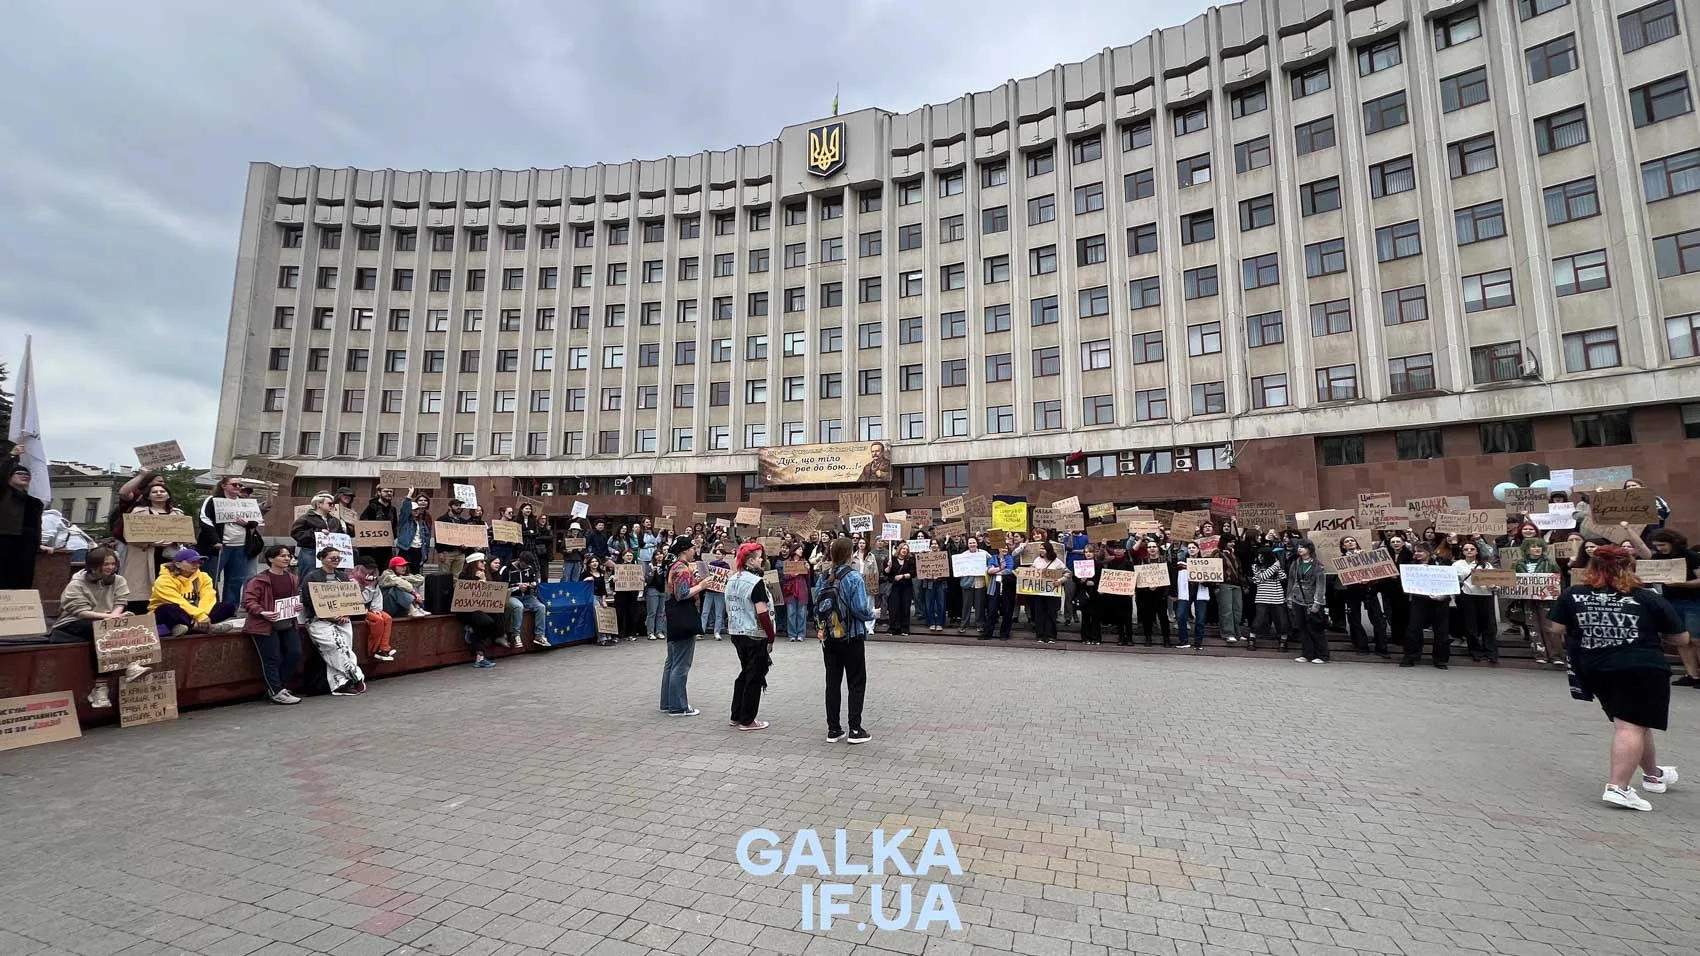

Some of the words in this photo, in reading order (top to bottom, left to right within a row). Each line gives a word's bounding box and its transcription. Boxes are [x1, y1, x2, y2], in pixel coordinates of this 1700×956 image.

[818, 455, 841, 463] тіло
[814, 463, 824, 472] до
[359, 530, 389, 538] 15150
[1189, 571, 1223, 581] СОВОК
[326, 600, 338, 610] НЕ
[1576, 611, 1640, 628] HEAVY
